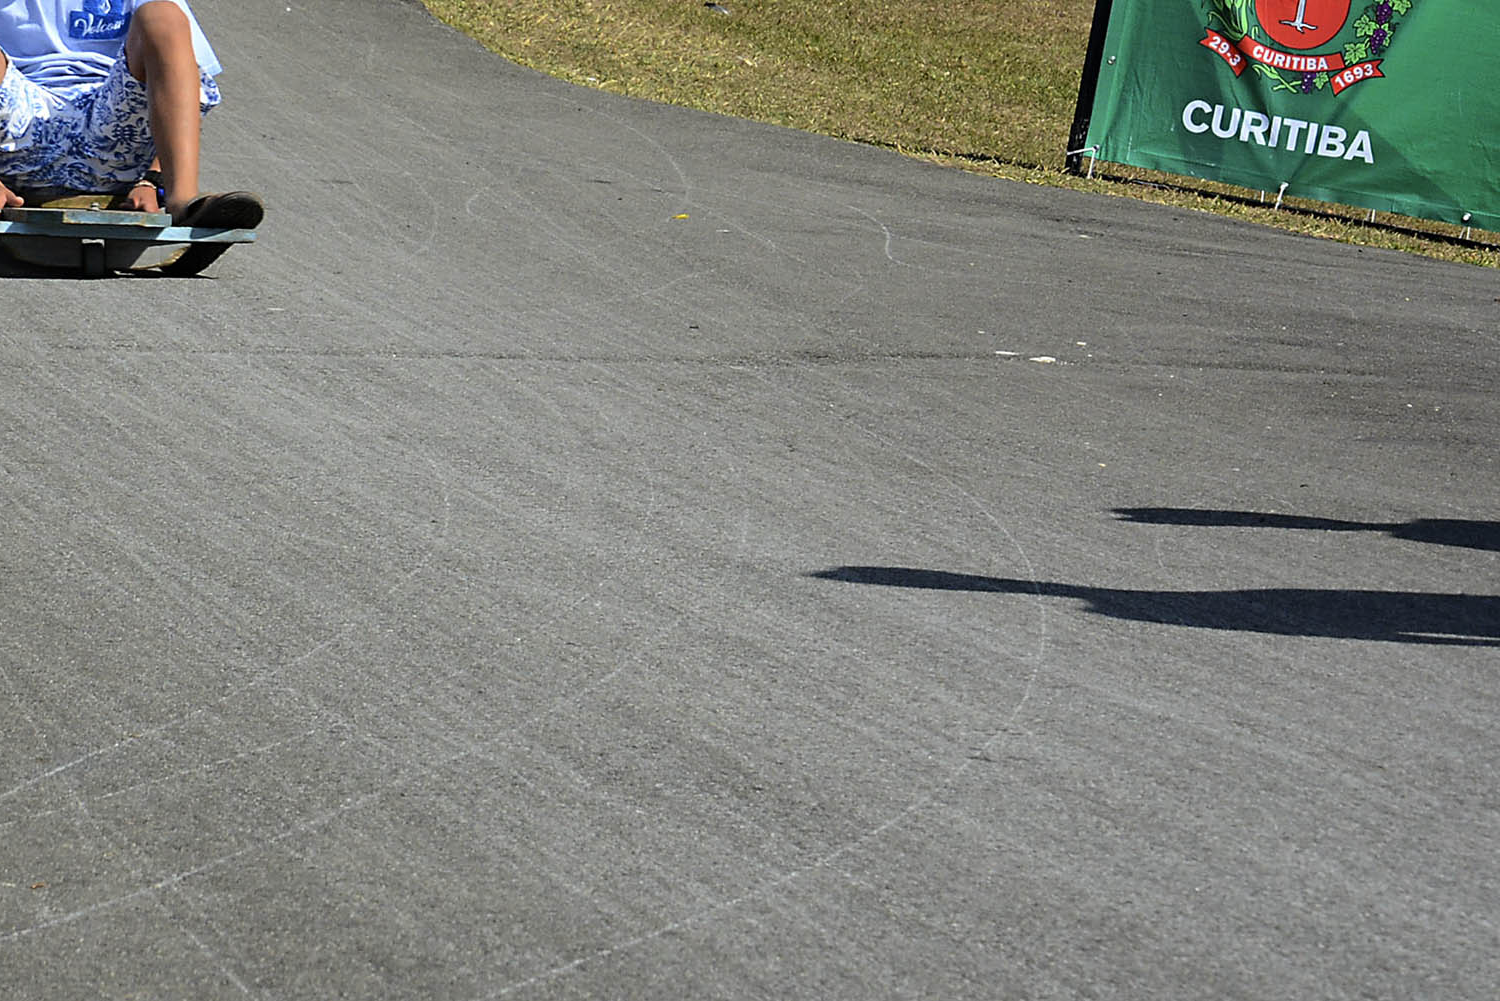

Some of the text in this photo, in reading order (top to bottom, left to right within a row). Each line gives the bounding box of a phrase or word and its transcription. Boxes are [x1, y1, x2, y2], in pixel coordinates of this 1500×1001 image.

[1208, 35, 1374, 88] 29-3 CURITIBA 1693
[1182, 99, 1375, 164] CURITIBA
